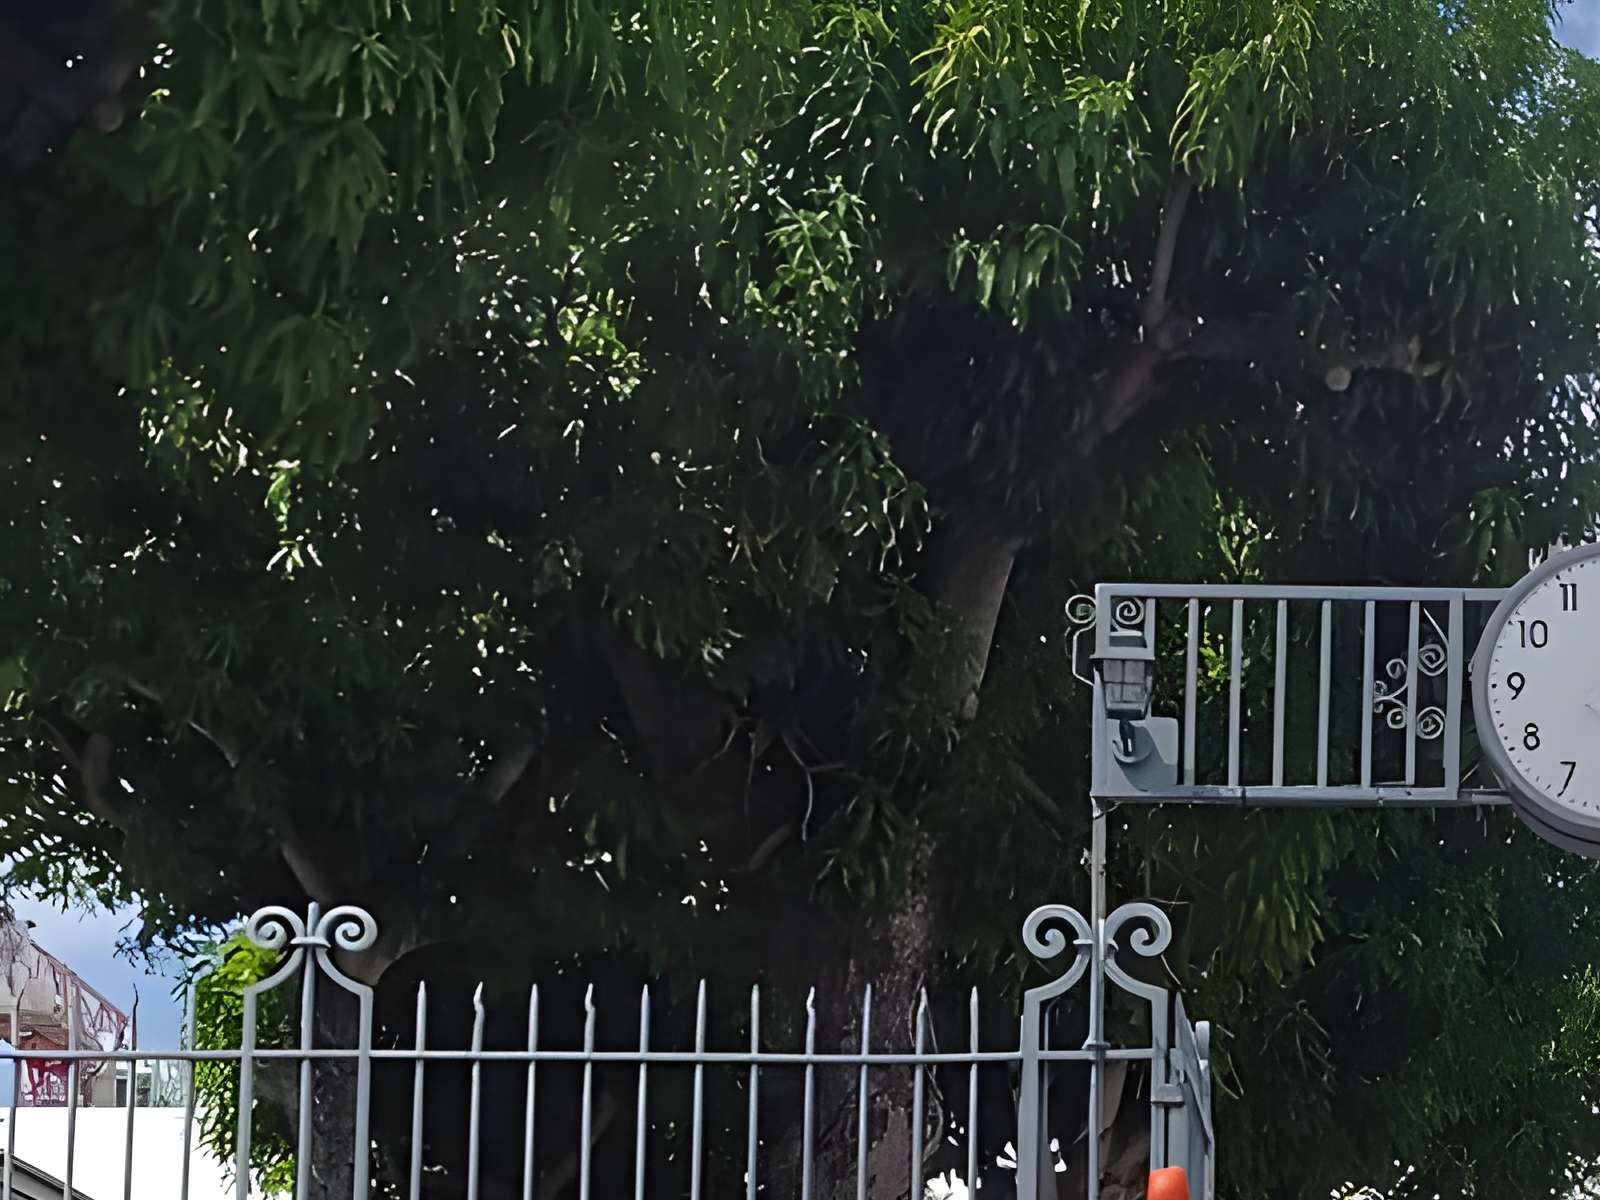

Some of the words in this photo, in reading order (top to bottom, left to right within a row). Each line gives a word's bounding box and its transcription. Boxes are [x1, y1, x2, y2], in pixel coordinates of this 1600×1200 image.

[1558, 582, 1578, 612] 11
[1517, 619, 1548, 649] 10
[1506, 671, 1526, 701] 9
[1522, 722, 1541, 752] 8
[1557, 760, 1577, 798] 7
